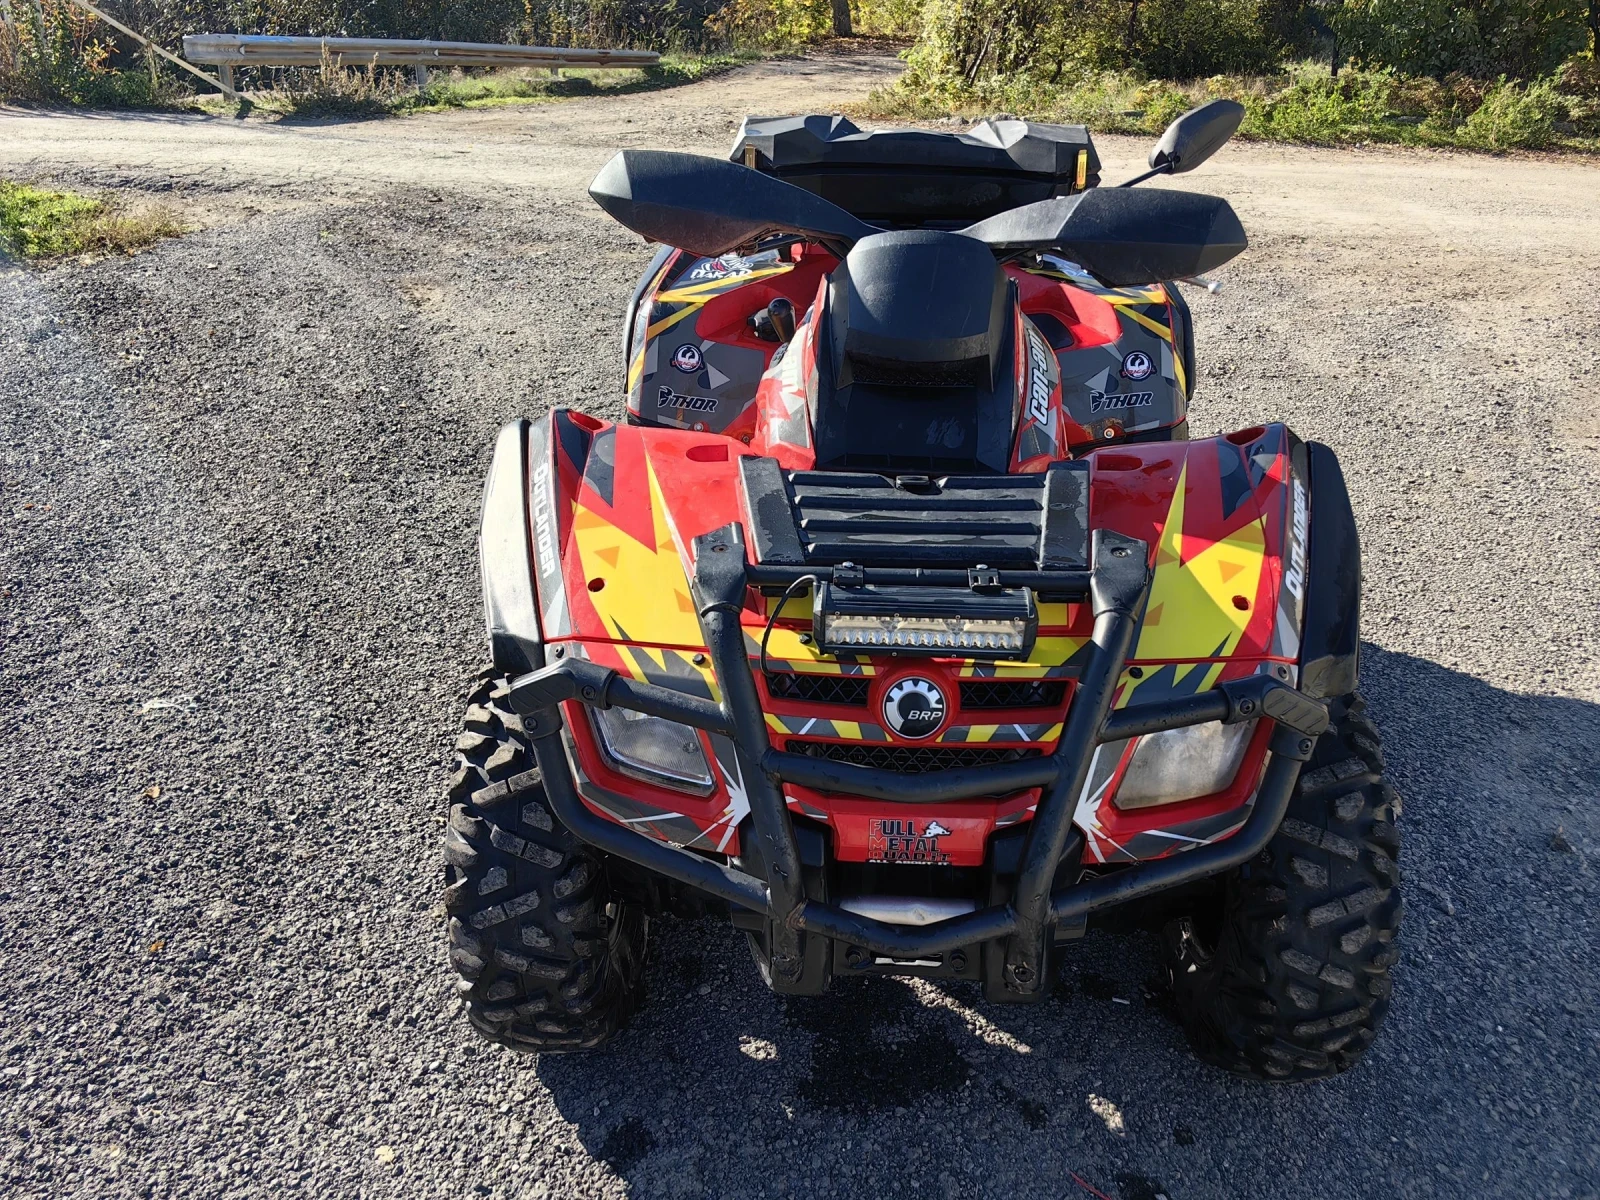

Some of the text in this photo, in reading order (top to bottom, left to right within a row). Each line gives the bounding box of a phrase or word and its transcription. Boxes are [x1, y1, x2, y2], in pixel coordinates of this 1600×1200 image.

[690, 268, 753, 280] DAKAR
[1027, 328, 1048, 426] can-am
[670, 395, 718, 413] THOR
[1104, 391, 1153, 410] THOR
[533, 462, 555, 579] OUTLANDER
[1285, 480, 1307, 600] OUTLANDER
[907, 710, 943, 721] BRP
[869, 818, 917, 837] FULL
[868, 836, 940, 852] METAL
